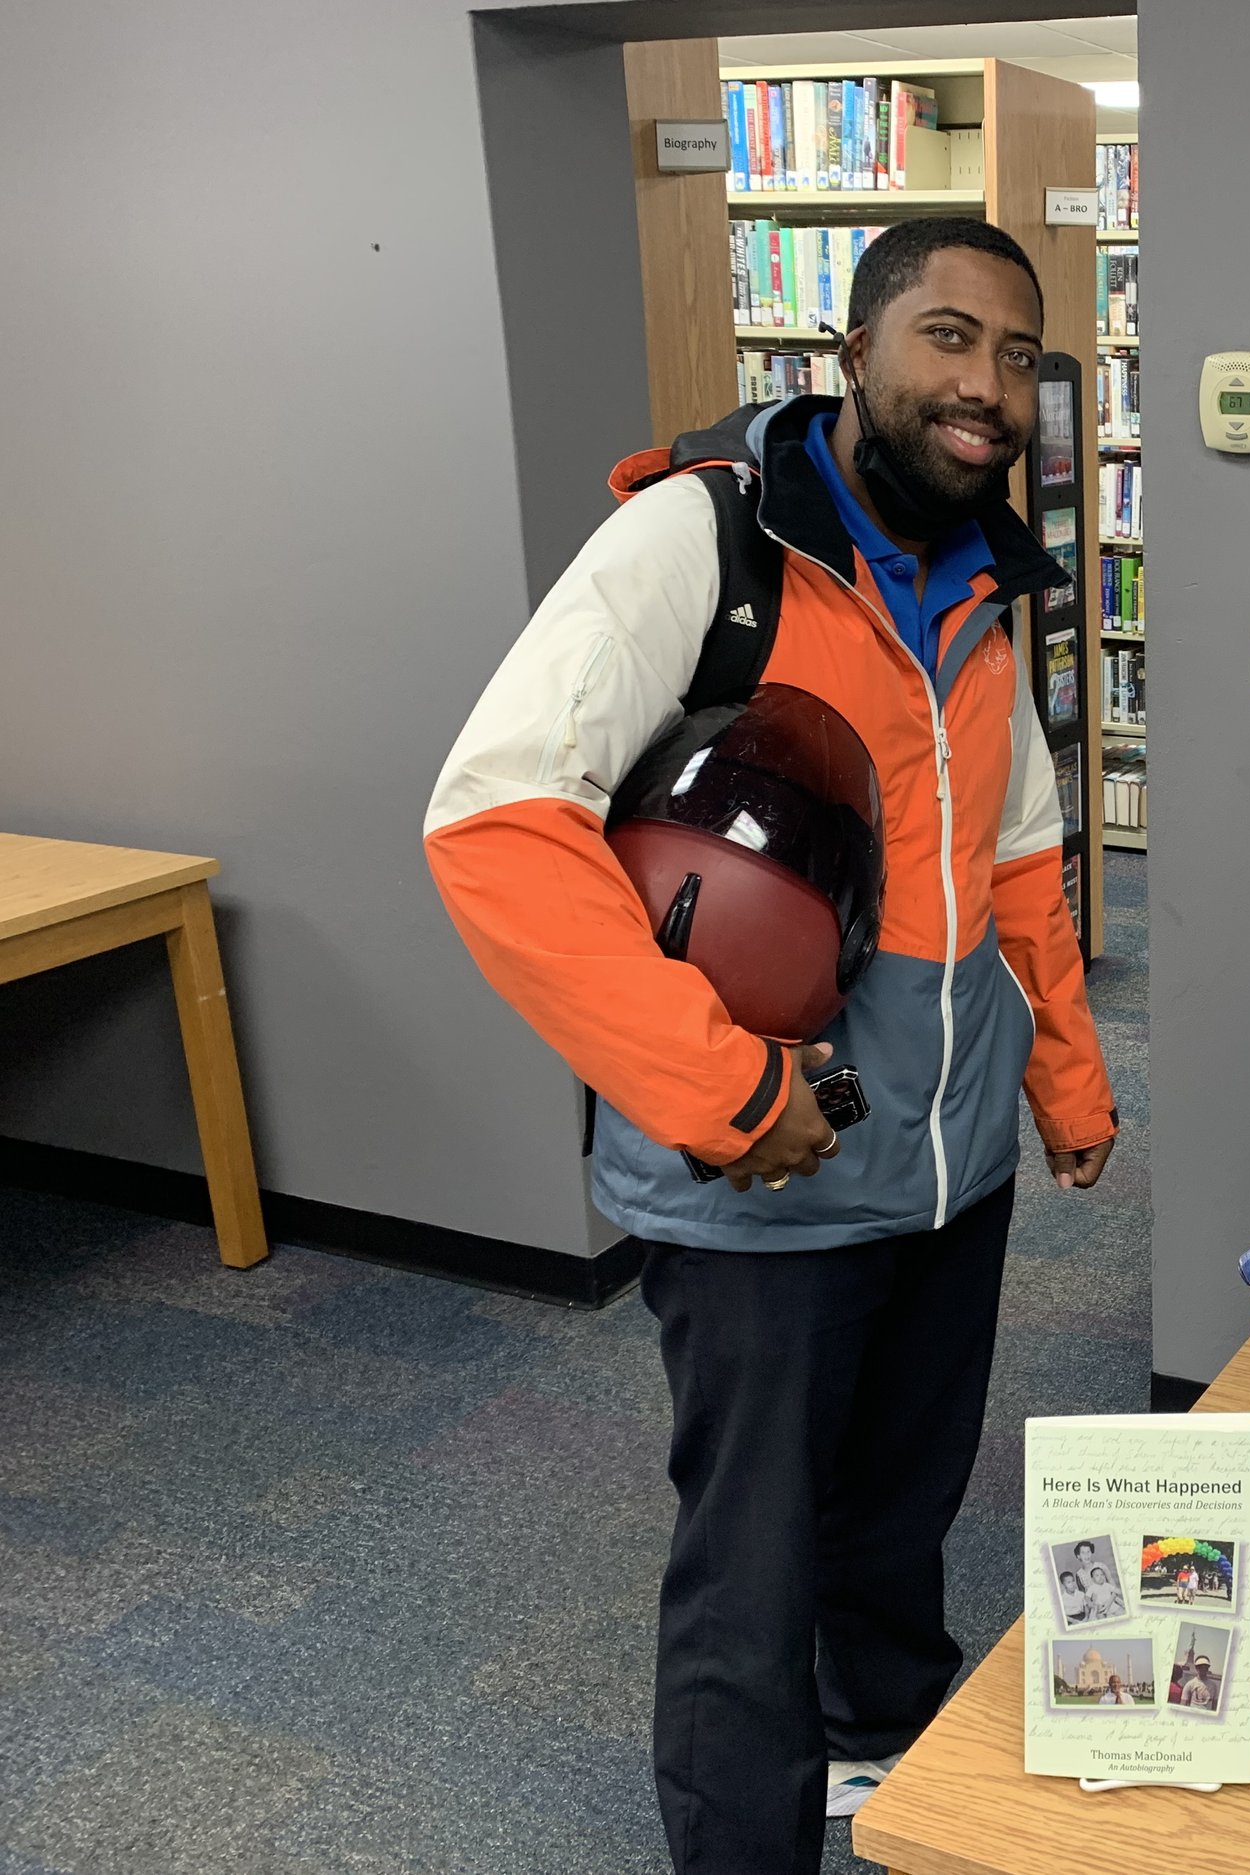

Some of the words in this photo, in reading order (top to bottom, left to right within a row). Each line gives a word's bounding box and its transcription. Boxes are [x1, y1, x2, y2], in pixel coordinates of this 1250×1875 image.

[664, 138, 717, 151] Biography
[1055, 204, 1061, 212] A
[1070, 205, 1088, 213] BRO
[730, 613, 758, 628] adidas
[1053, 641, 1069, 658] JAMES
[1043, 1477, 1082, 1493] Here
[1086, 1478, 1101, 1493] Is
[1106, 1478, 1151, 1494] What
[1156, 1479, 1242, 1498] Happened
[1042, 1499, 1050, 1508] A
[1052, 1499, 1079, 1509] Black
[1081, 1499, 1113, 1509] Man's
[1115, 1499, 1171, 1510] Discoveries
[1174, 1500, 1193, 1510] and
[1195, 1500, 1242, 1511] Decisions
[1090, 1749, 1132, 1762] Thomas
[1134, 1750, 1192, 1762] MacDonald
[1108, 1763, 1118, 1772] An
[1120, 1763, 1175, 1775] Autobiography
